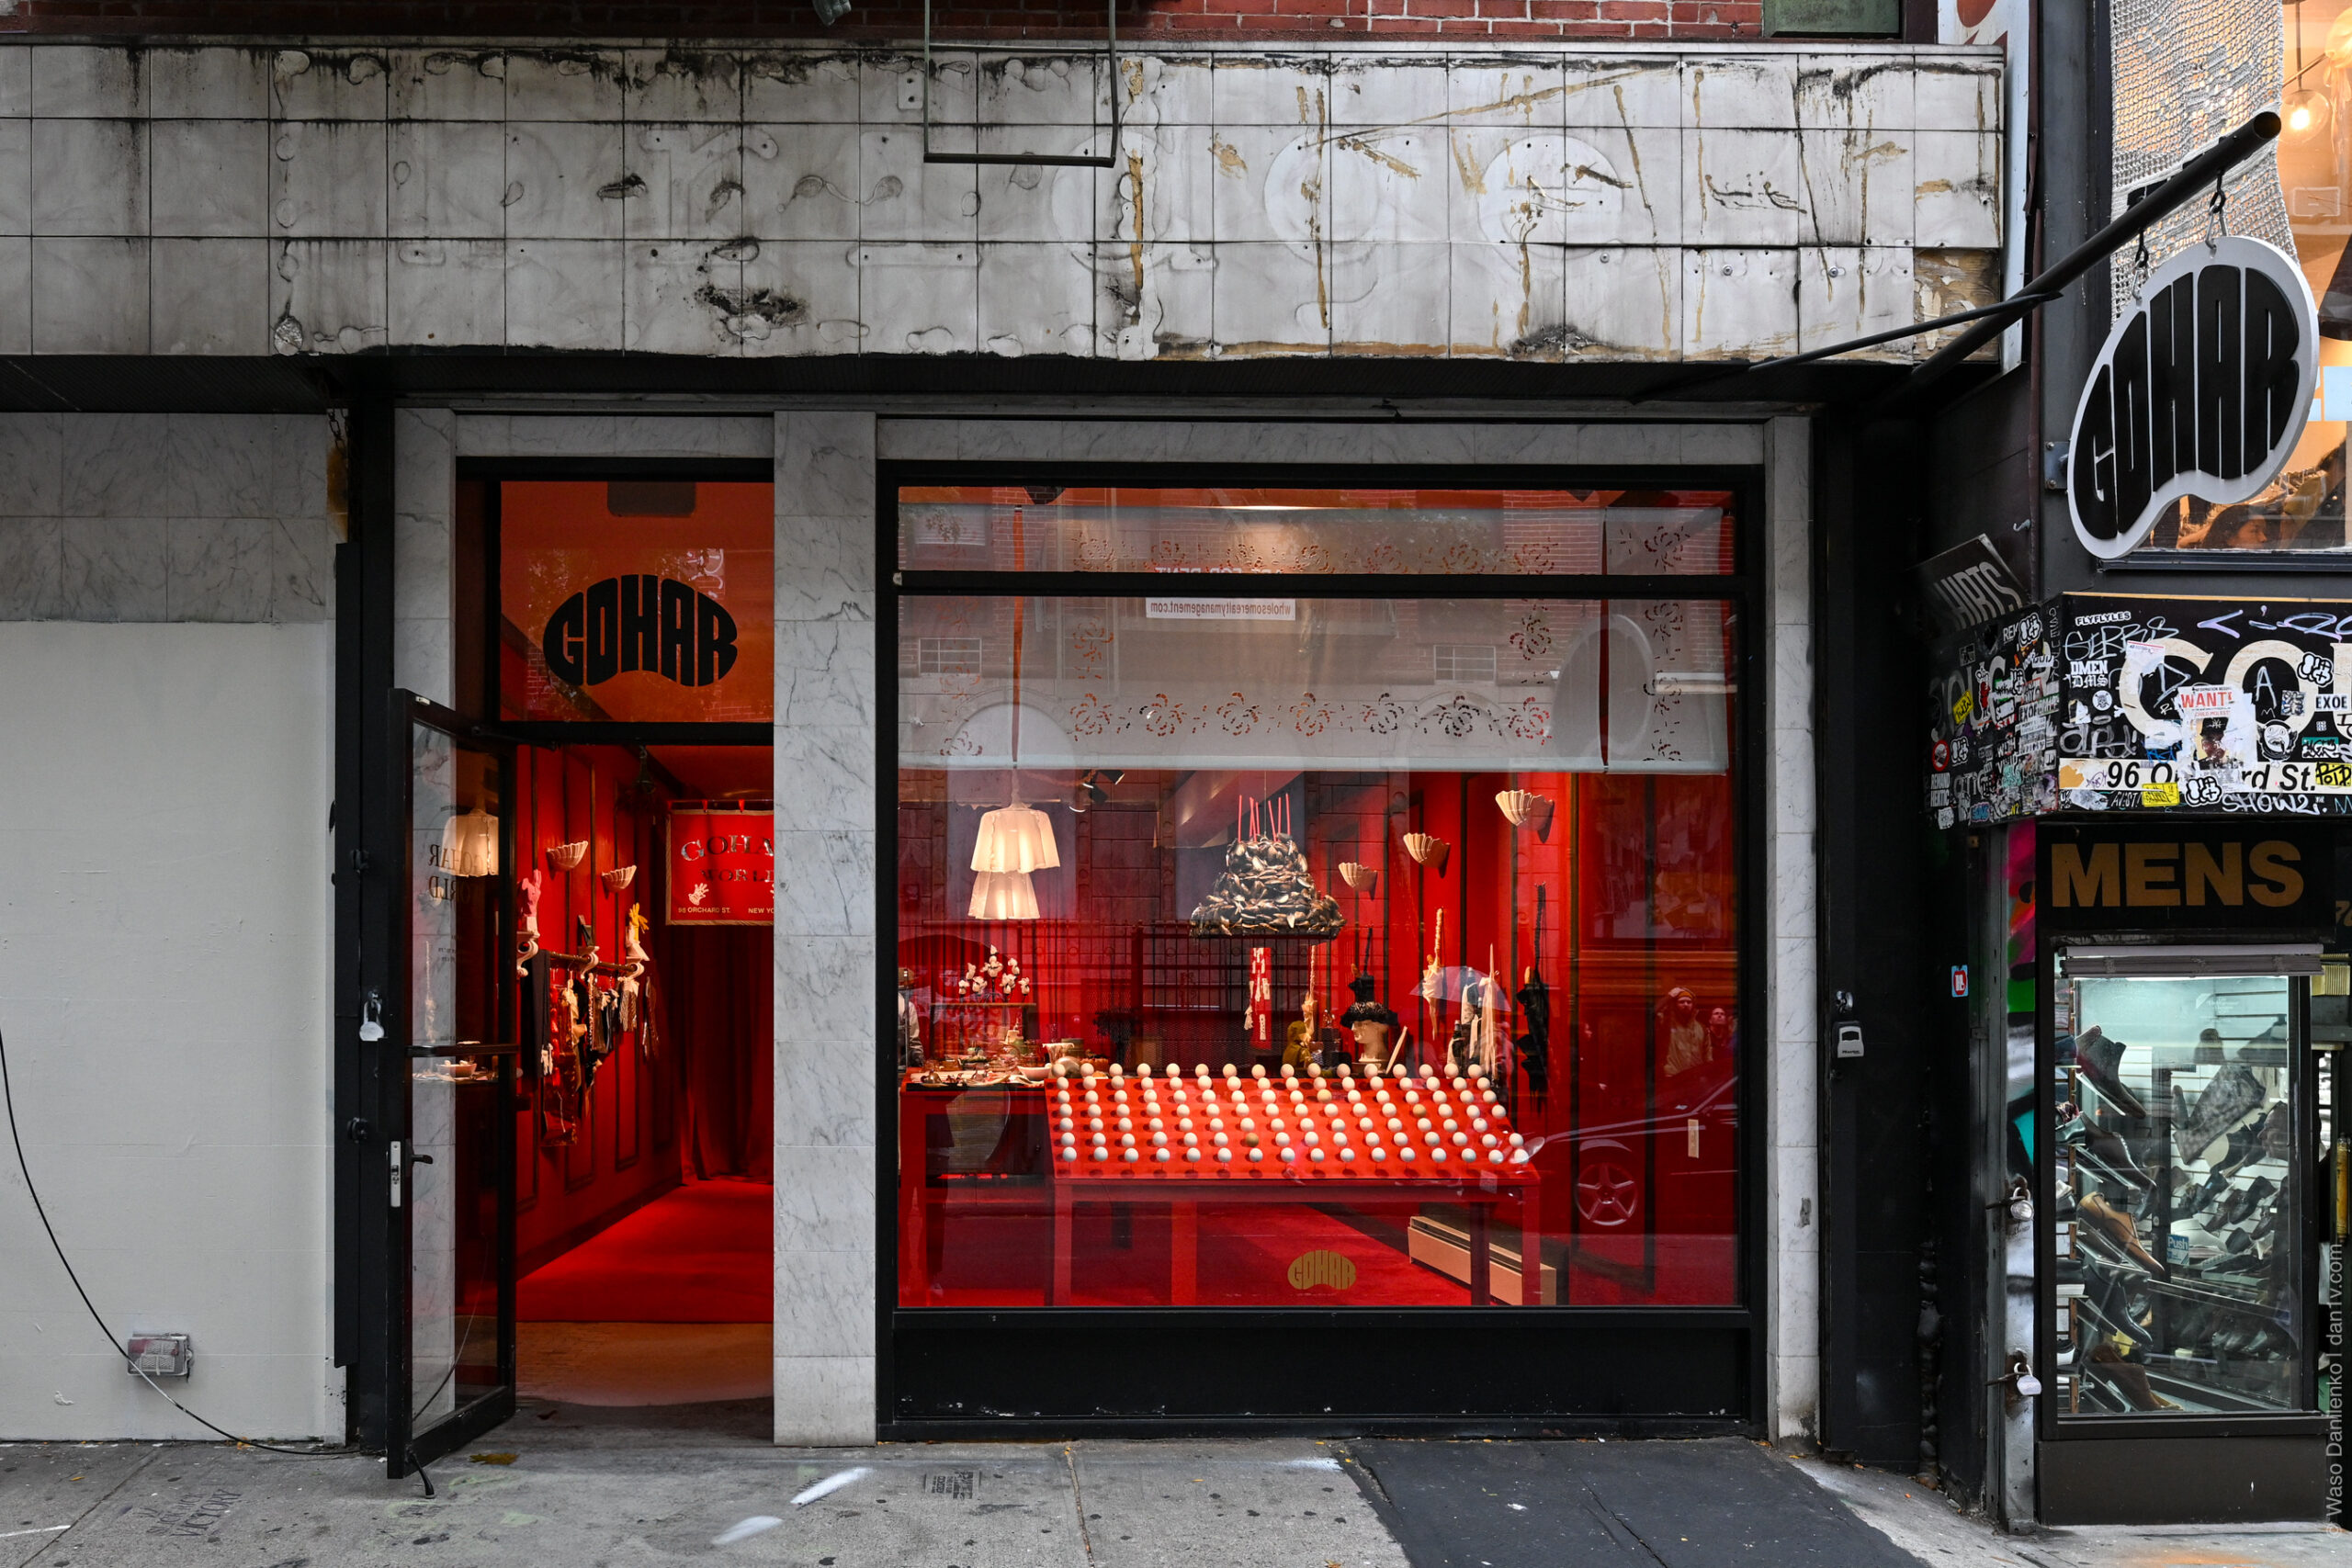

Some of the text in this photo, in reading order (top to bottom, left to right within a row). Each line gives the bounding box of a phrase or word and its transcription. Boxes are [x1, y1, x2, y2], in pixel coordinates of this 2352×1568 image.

[2074, 265, 2300, 540] GOHAR
[543, 574, 738, 686] GOHAR
[2070, 660, 2109, 675] DMEN
[2071, 674, 2109, 688] DMS
[2107, 761, 2141, 788] 96
[2279, 763, 2316, 791] St.
[681, 834, 774, 862] GOHA
[2051, 841, 2304, 908] MENS
[2168, 1236, 2188, 1250] Push
[1287, 1249, 1357, 1290] GOHAR
[169, 1488, 242, 1537] VICTORY
